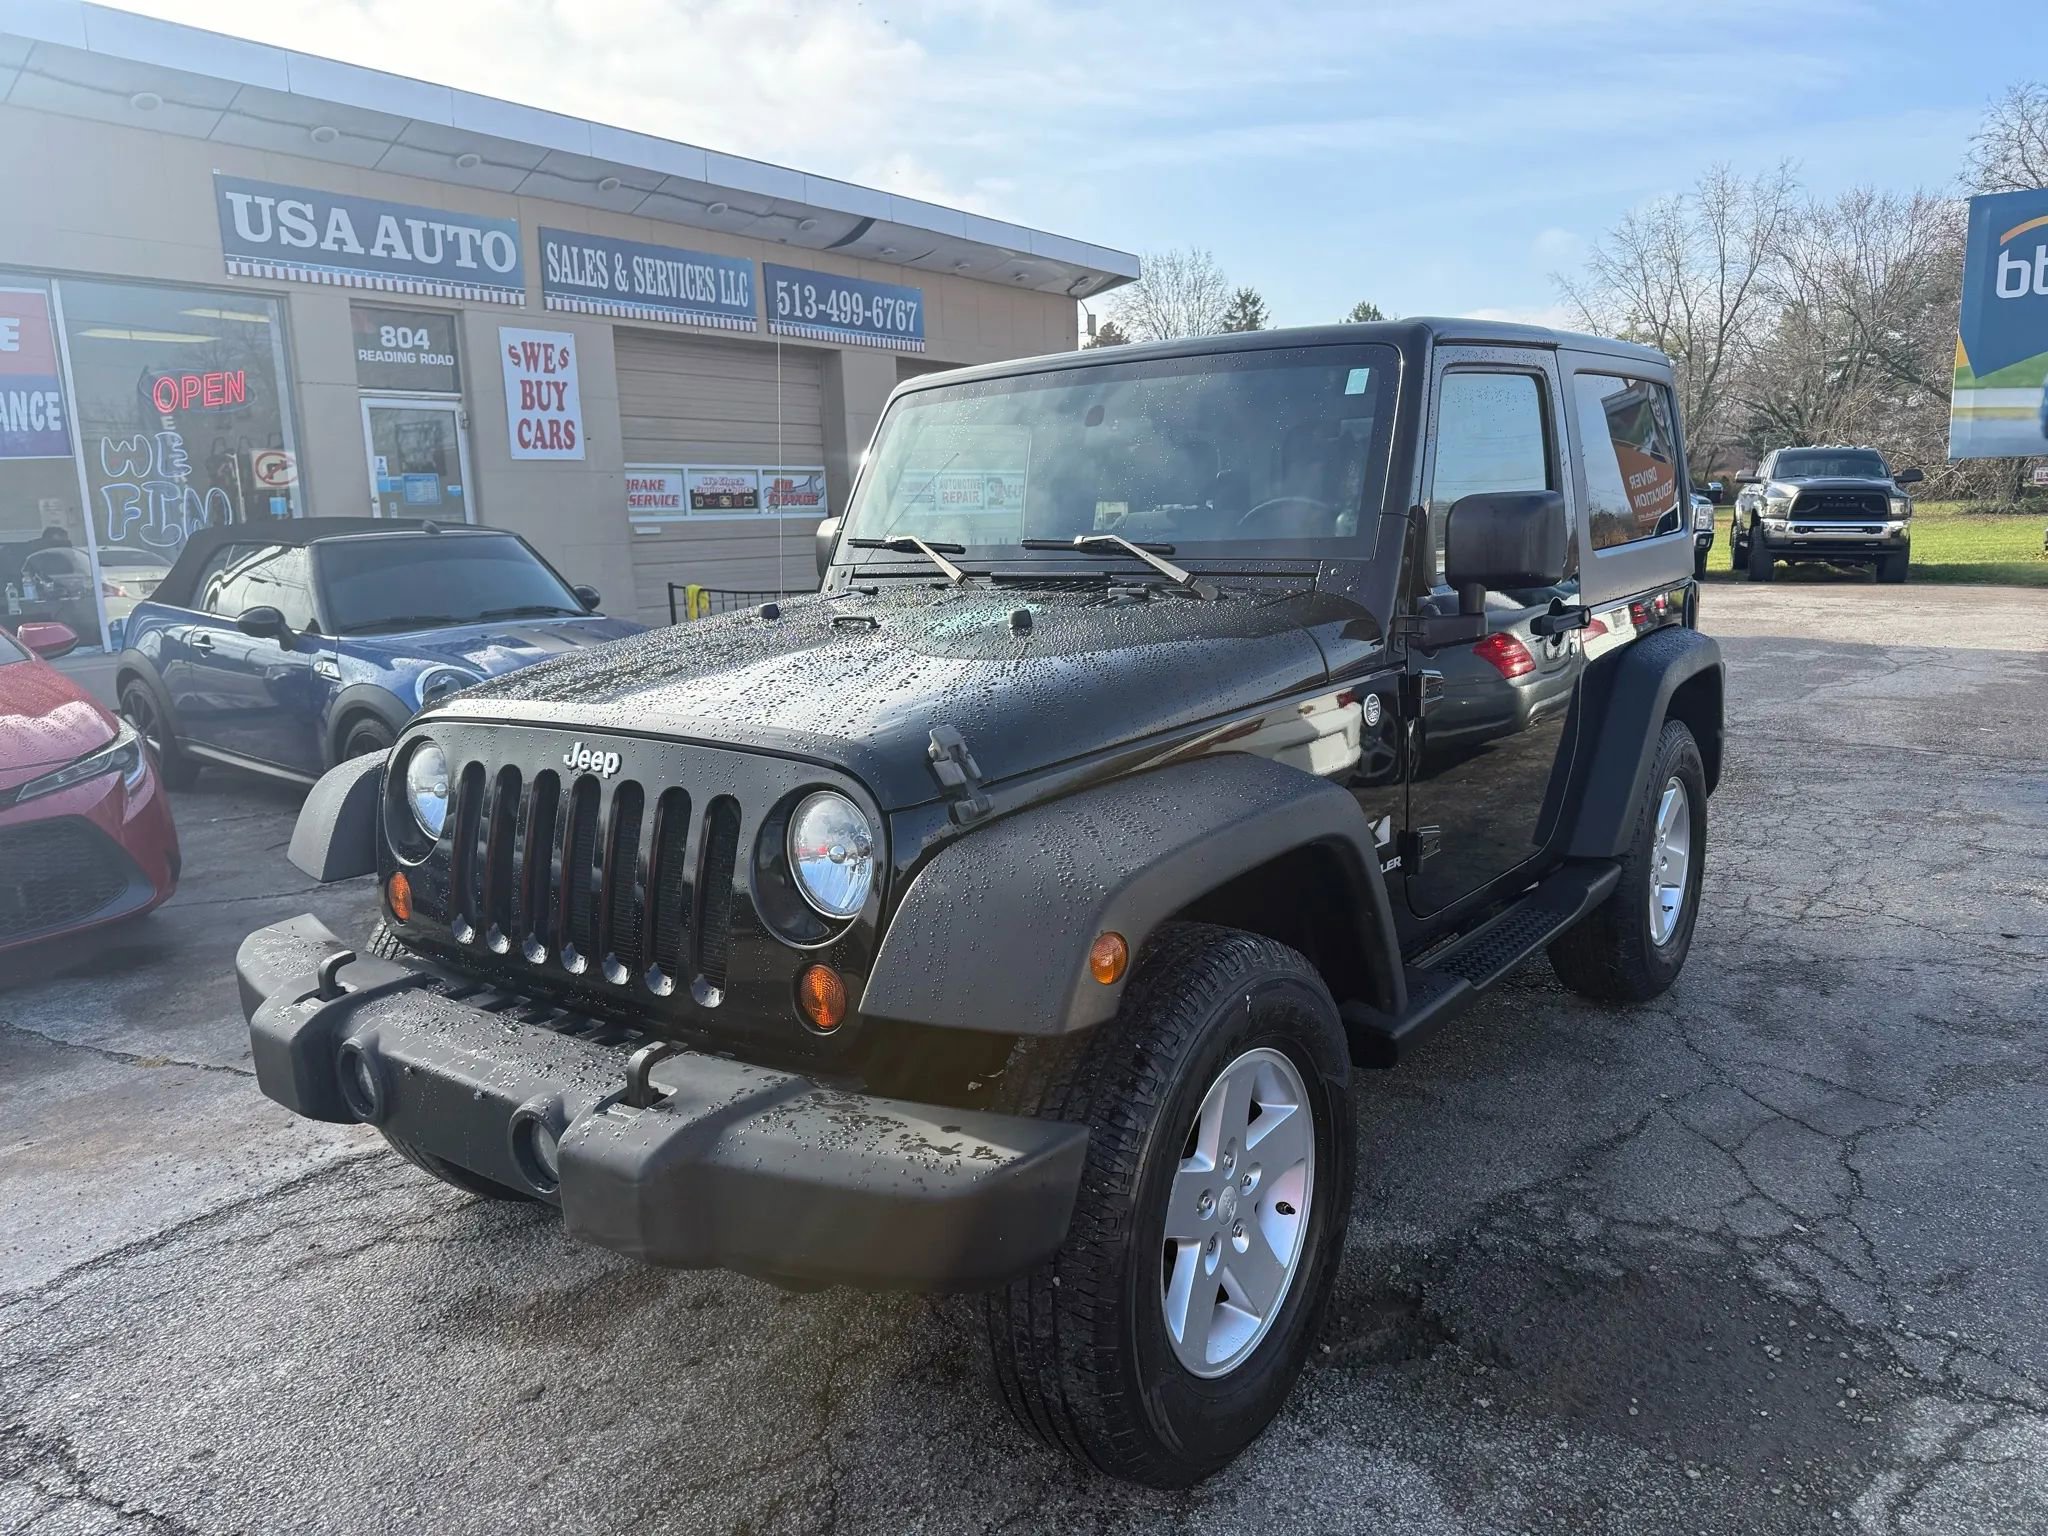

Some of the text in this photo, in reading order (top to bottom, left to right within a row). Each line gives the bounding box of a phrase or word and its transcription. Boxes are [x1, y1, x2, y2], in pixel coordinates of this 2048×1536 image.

[225, 192, 517, 273] USA AUTO
[547, 242, 749, 308] SALES & SERVICES LLC
[776, 280, 918, 332] 513-499-6767
[380, 325, 430, 350] 804
[358, 349, 455, 366] READING ROAD
[153, 371, 245, 413] OPEN
[520, 379, 568, 412] BUY
[517, 418, 576, 450] CARS
[101, 432, 192, 478] WE
[628, 494, 680, 508] SERVICE
[942, 490, 980, 505] REPAIR
[563, 741, 622, 779] Jeep
